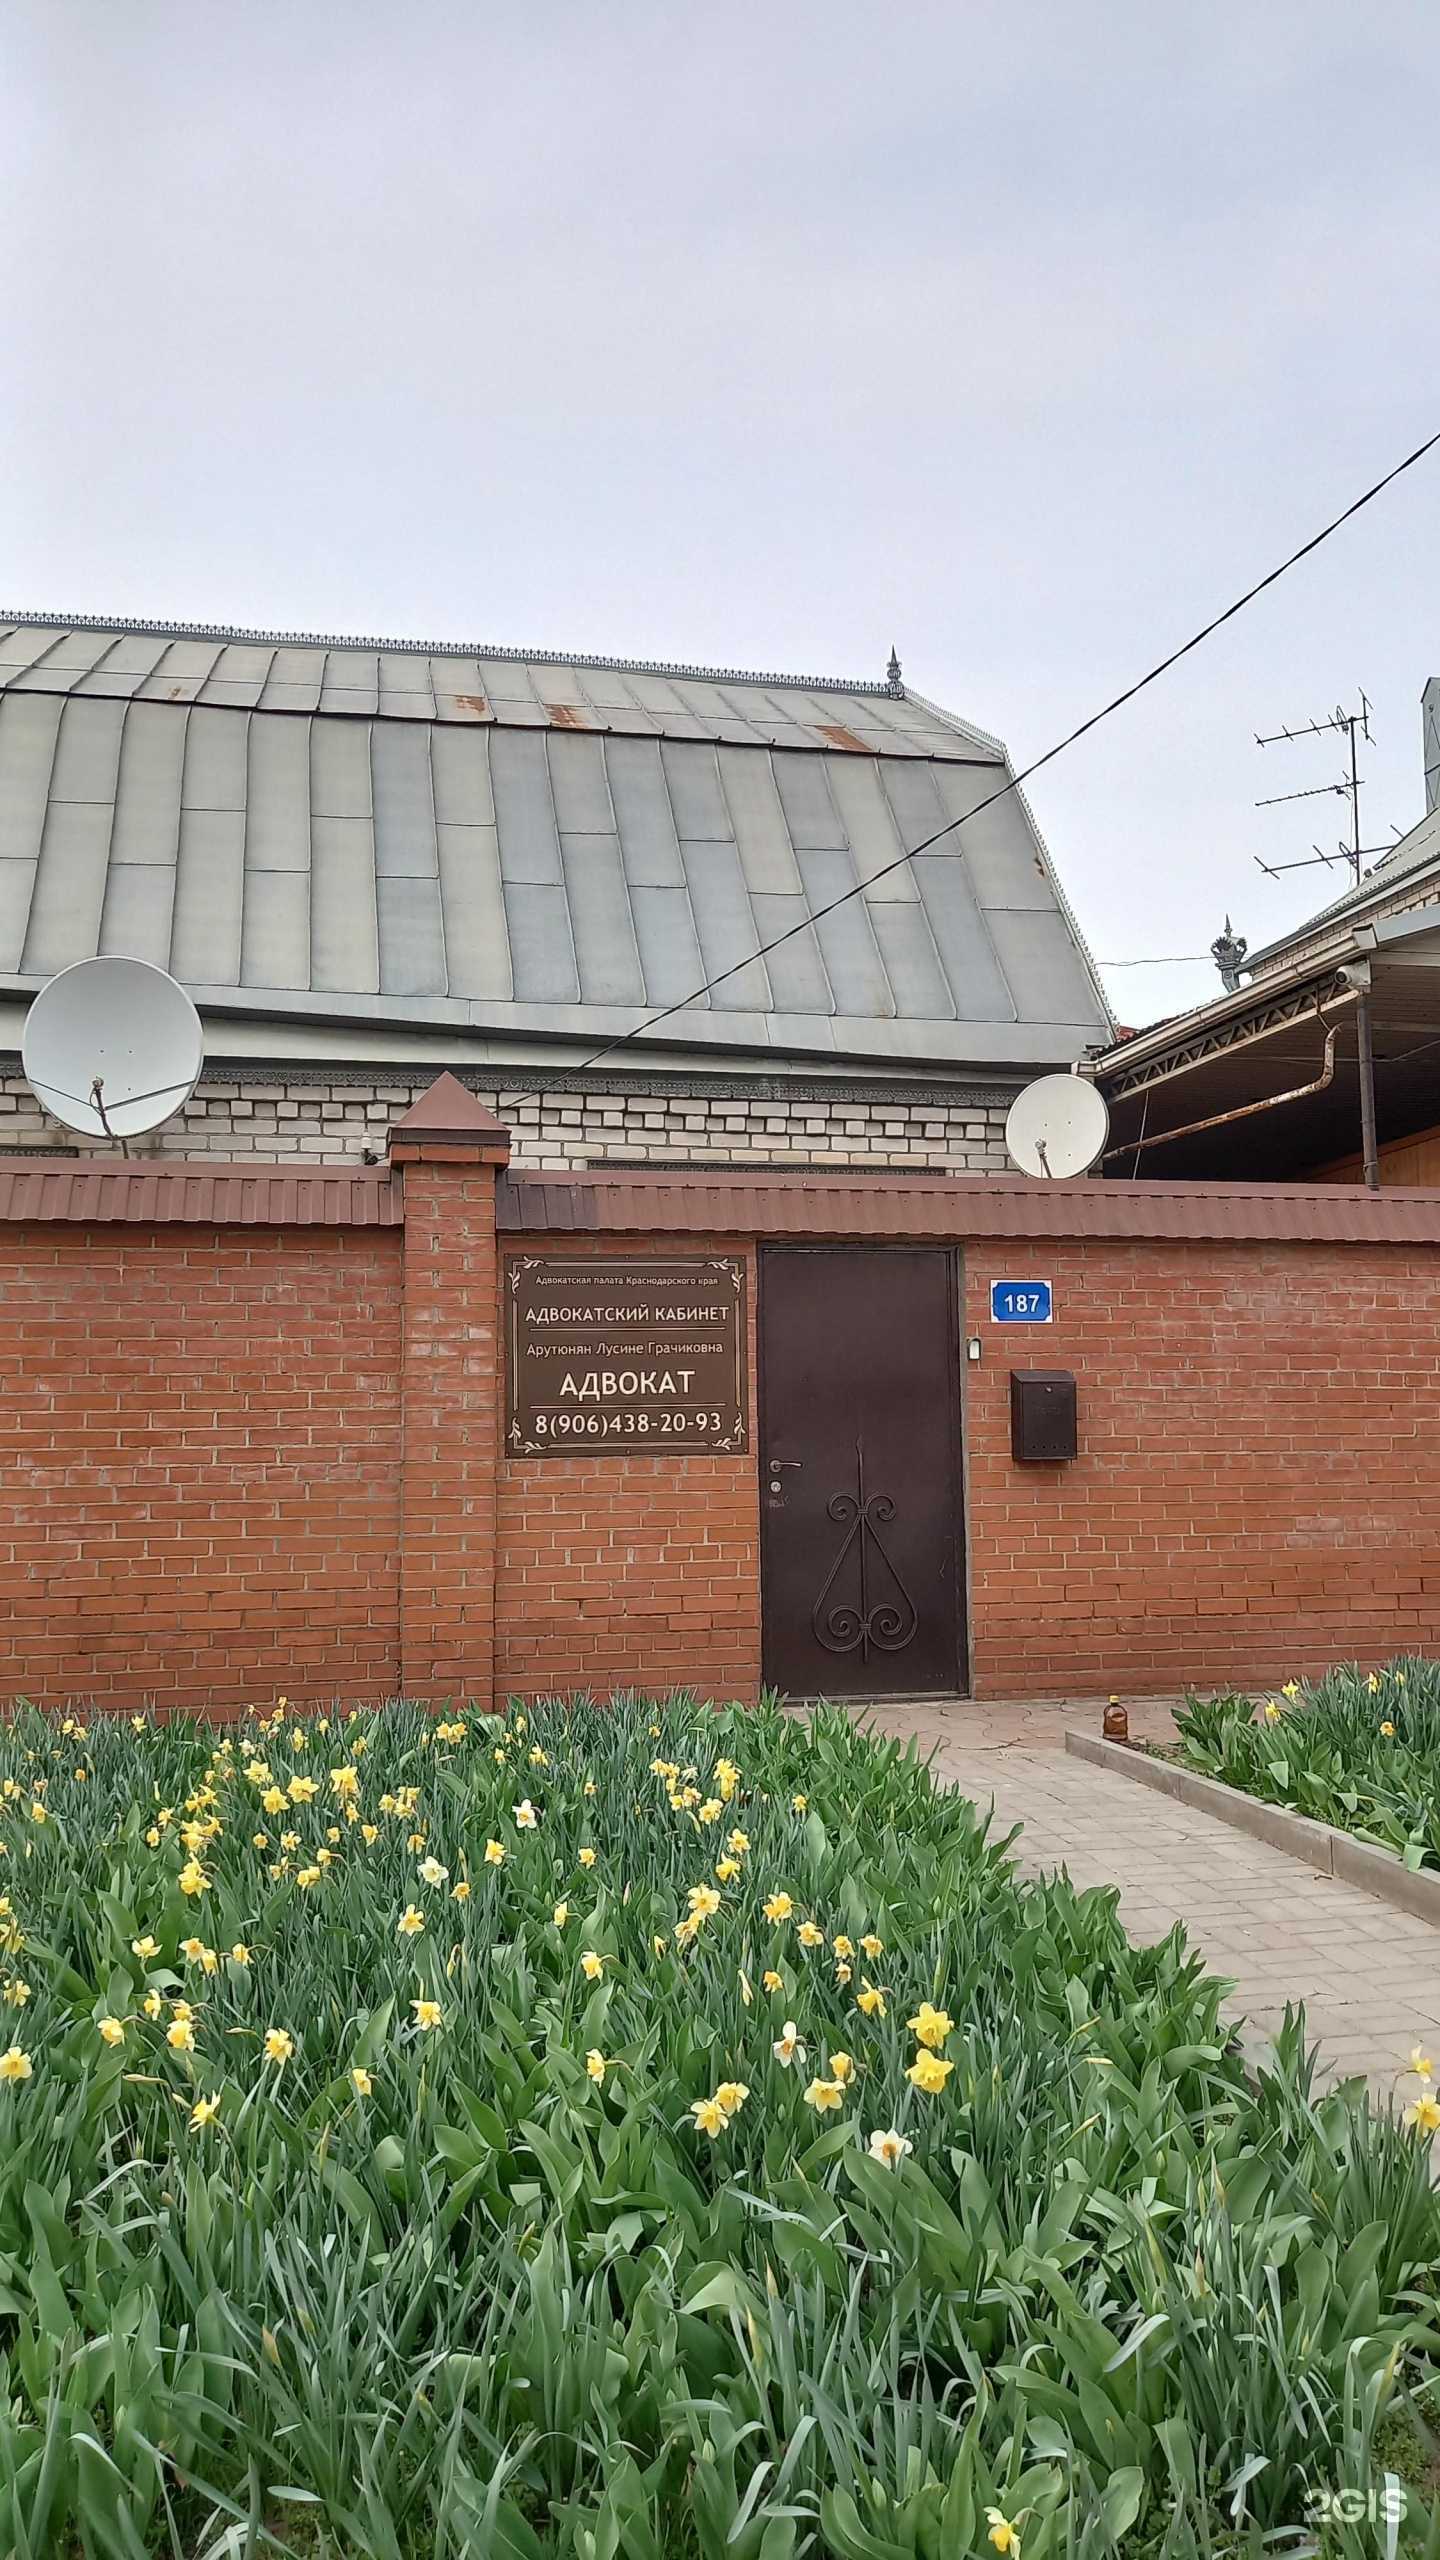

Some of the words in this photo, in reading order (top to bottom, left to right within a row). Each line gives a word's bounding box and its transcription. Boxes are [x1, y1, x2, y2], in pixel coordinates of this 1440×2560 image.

[535, 1275, 592, 1286] Адвокатская
[593, 1277, 624, 1285] палата
[626, 1275, 696, 1287] Краснодарского
[698, 1278, 719, 1287] края
[1004, 1294, 1040, 1313] 187
[525, 1303, 650, 1325] АДВОКАТСКИЙ
[655, 1306, 729, 1322] КАБИНЕТ
[526, 1343, 592, 1358] Арутюнян
[596, 1343, 644, 1357] Лусине
[648, 1341, 723, 1355] Грачиковна
[559, 1370, 696, 1402] АДВОКАТ
[535, 1412, 722, 1438] 8(906)438-20-93
